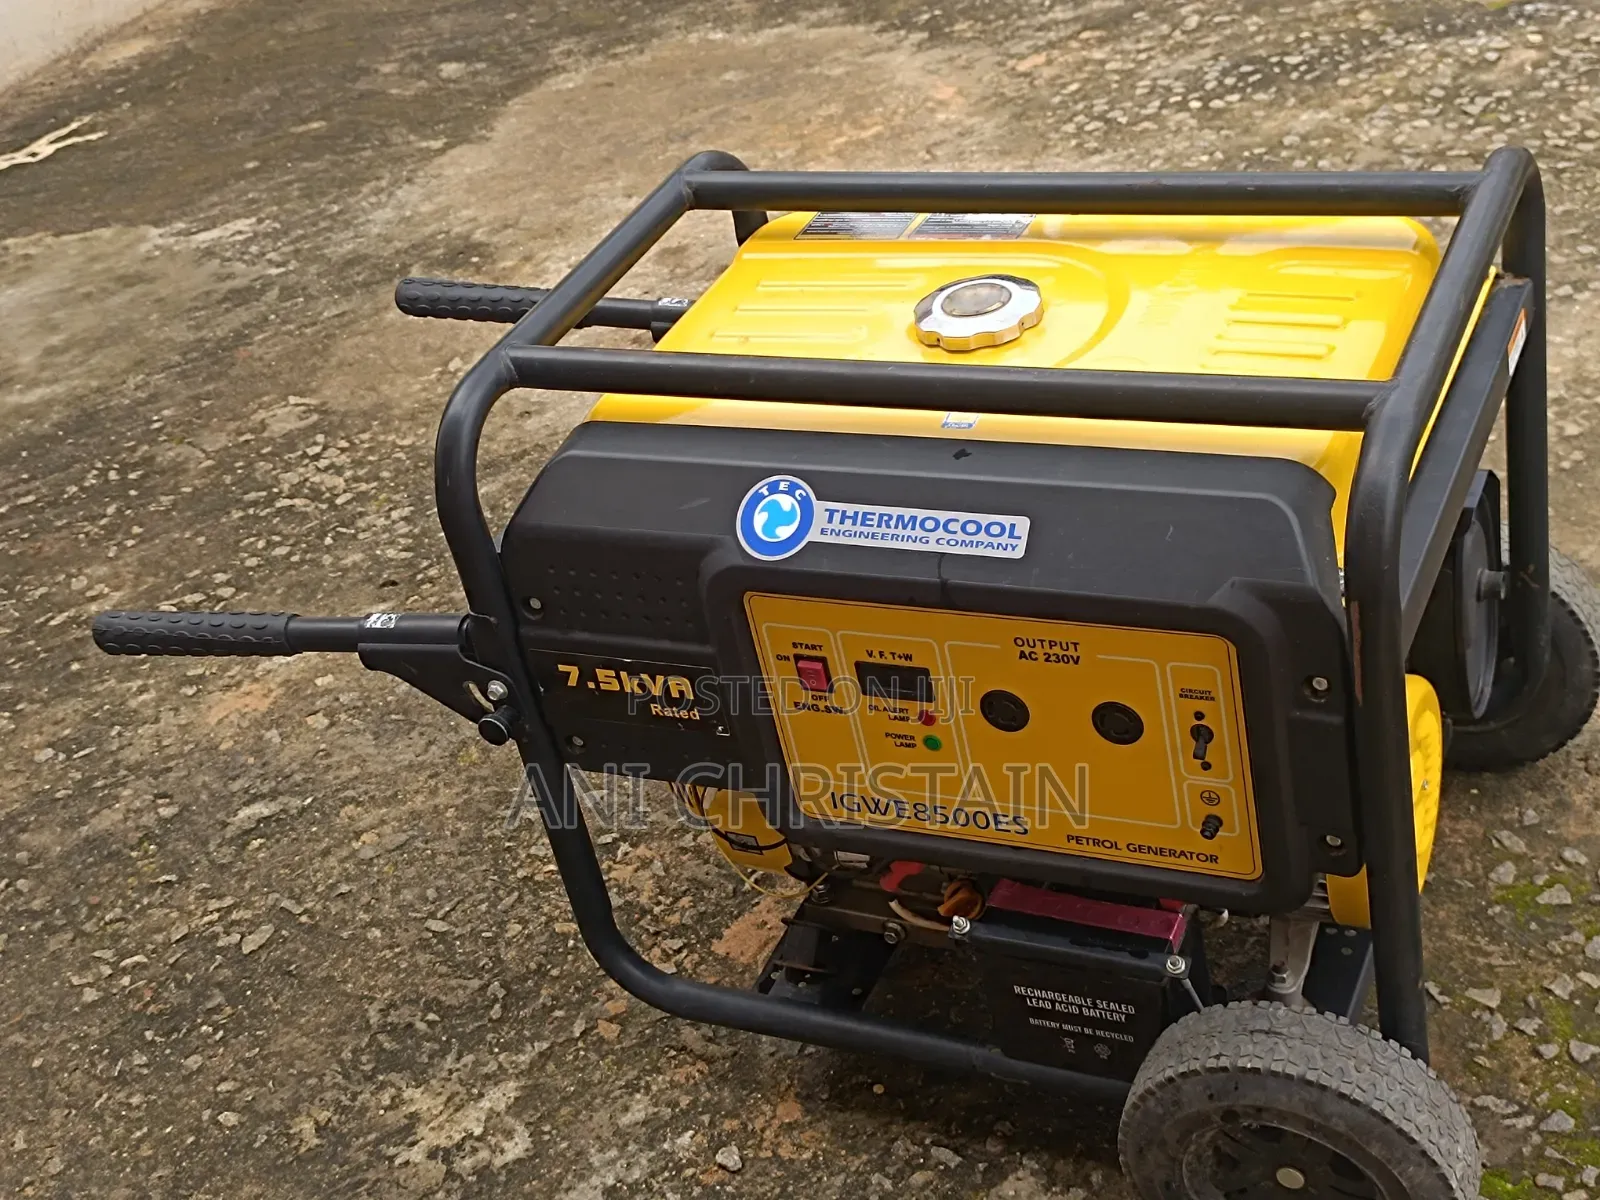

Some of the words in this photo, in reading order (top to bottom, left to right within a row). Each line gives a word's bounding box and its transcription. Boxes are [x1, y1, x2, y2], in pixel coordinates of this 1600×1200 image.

[758, 480, 807, 501] TEC
[824, 508, 1022, 540] THERMOCOOL
[819, 527, 931, 546] ENGINEERING
[935, 537, 1020, 553] COMPANY
[791, 641, 824, 652] START
[1013, 636, 1081, 653] OUTPUT
[776, 653, 791, 662] ON
[1018, 650, 1039, 662] AC
[1043, 652, 1081, 666] 230V
[1179, 693, 1216, 702] BREAKER
[1180, 688, 1212, 696] CIRCUIT
[650, 703, 701, 721] Rated
[888, 714, 910, 722] LAMP
[885, 732, 916, 742] POWER
[894, 741, 917, 749] LAMP
[1066, 834, 1122, 852] PETROL
[1126, 842, 1220, 865] GENERATOR
[1013, 984, 1093, 1008] RECHARGEABLE
[1096, 999, 1135, 1015] SEALED
[1026, 997, 1052, 1010] LEAD
[1055, 1002, 1080, 1015] ACID
[1082, 1006, 1126, 1023] BATTERY
[1028, 1017, 1060, 1030] BATTERY
[1061, 1023, 1082, 1033] MUST
[1083, 1027, 1095, 1035] BE
[1095, 1029, 1134, 1043] RECYCLED
